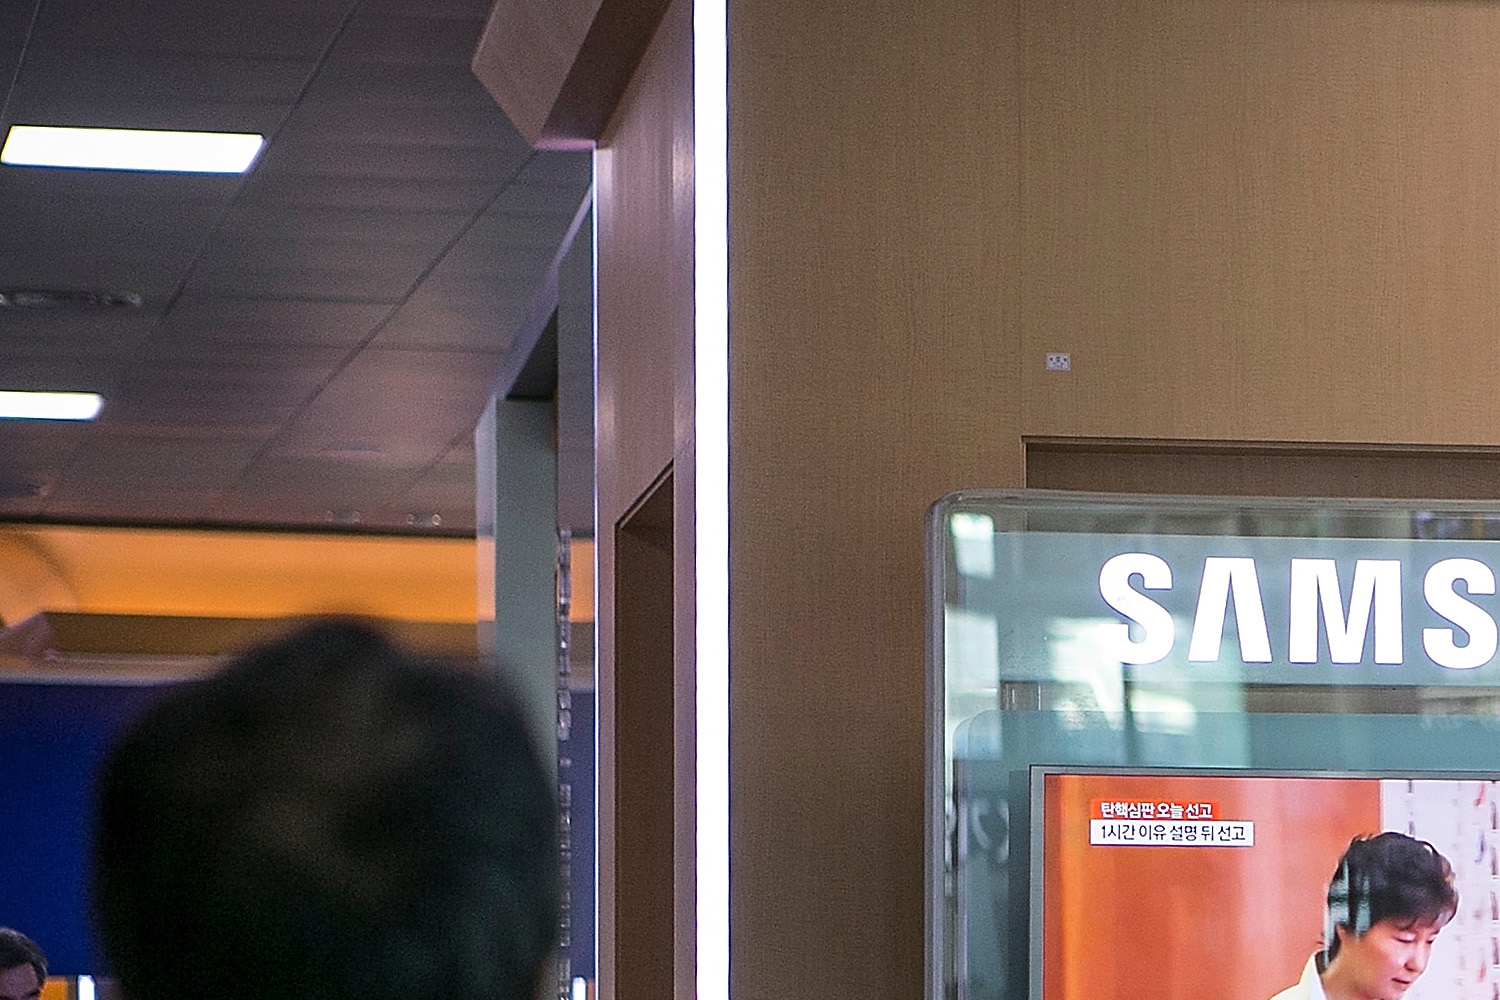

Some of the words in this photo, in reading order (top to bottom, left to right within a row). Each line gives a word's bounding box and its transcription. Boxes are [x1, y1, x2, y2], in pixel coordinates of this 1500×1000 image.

[1101, 801, 1154, 819] 탄핵심판
[1156, 802, 1183, 818] 오늘
[1186, 803, 1213, 820] 선고
[1101, 825, 1136, 840] 1시간
[1138, 825, 1167, 841] 이유
[1170, 824, 1198, 842] 설명
[1201, 825, 1215, 841] 뒤
[1218, 826, 1246, 842] 선고
